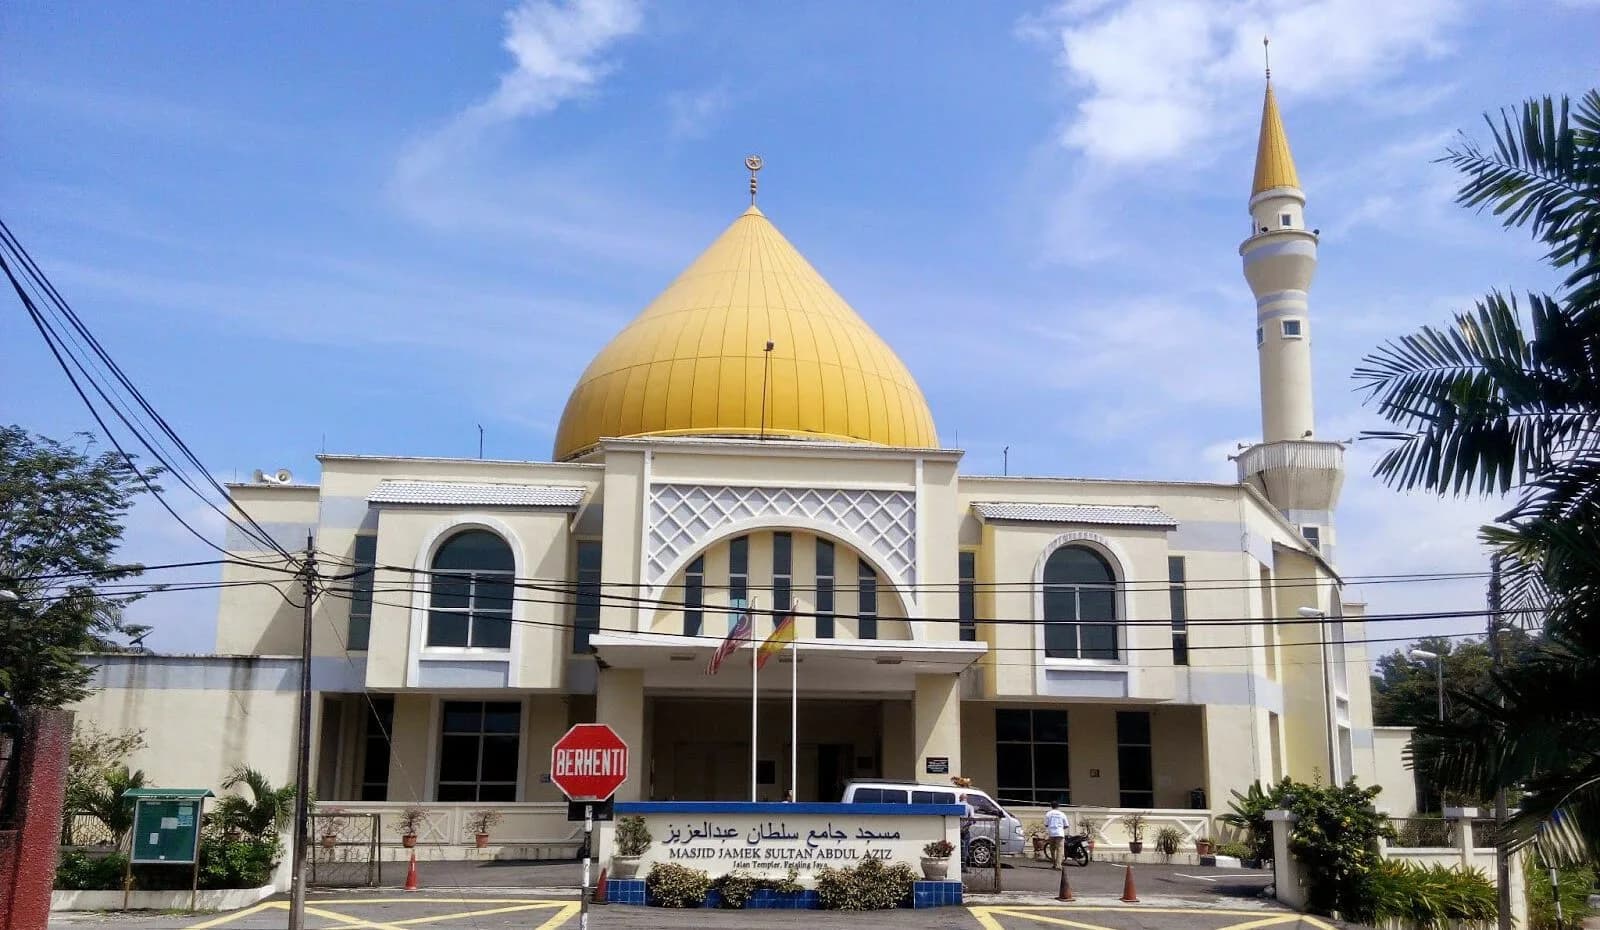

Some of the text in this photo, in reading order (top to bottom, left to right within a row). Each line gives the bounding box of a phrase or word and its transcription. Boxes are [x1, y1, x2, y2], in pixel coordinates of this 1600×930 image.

[556, 748, 624, 776] BERHENTI
[747, 822, 799, 845] سلطان
[806, 822, 847, 848] جامع
[855, 827, 901, 844] مسجد
[669, 847, 893, 860] MASJID JAMEK SULTAN ABDUL AZIZ
[733, 860, 751, 869] Jalan
[784, 861, 811, 870] Petaling
